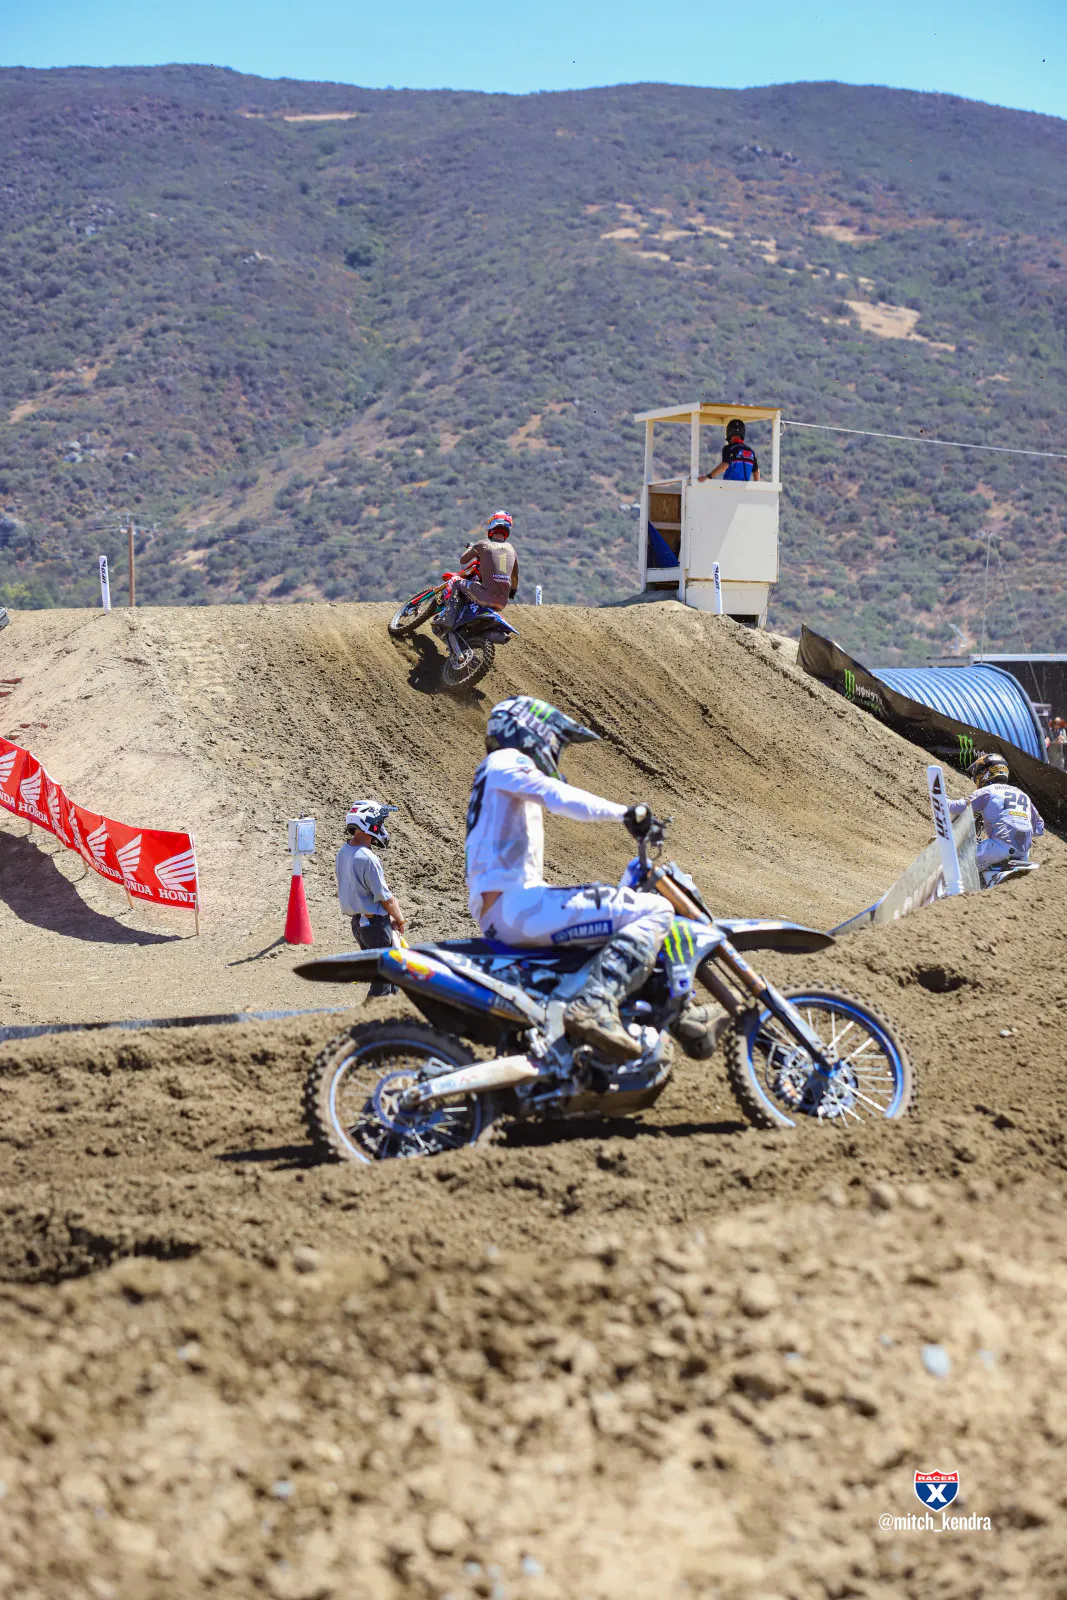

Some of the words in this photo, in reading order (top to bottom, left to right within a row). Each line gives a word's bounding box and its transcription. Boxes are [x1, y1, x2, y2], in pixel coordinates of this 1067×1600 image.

[497, 553, 507, 574] 1
[1003, 791, 1029, 811] 24
[932, 795, 945, 838] UFO
[125, 879, 154, 897] ONDA
[567, 921, 609, 938] YAMAHA
